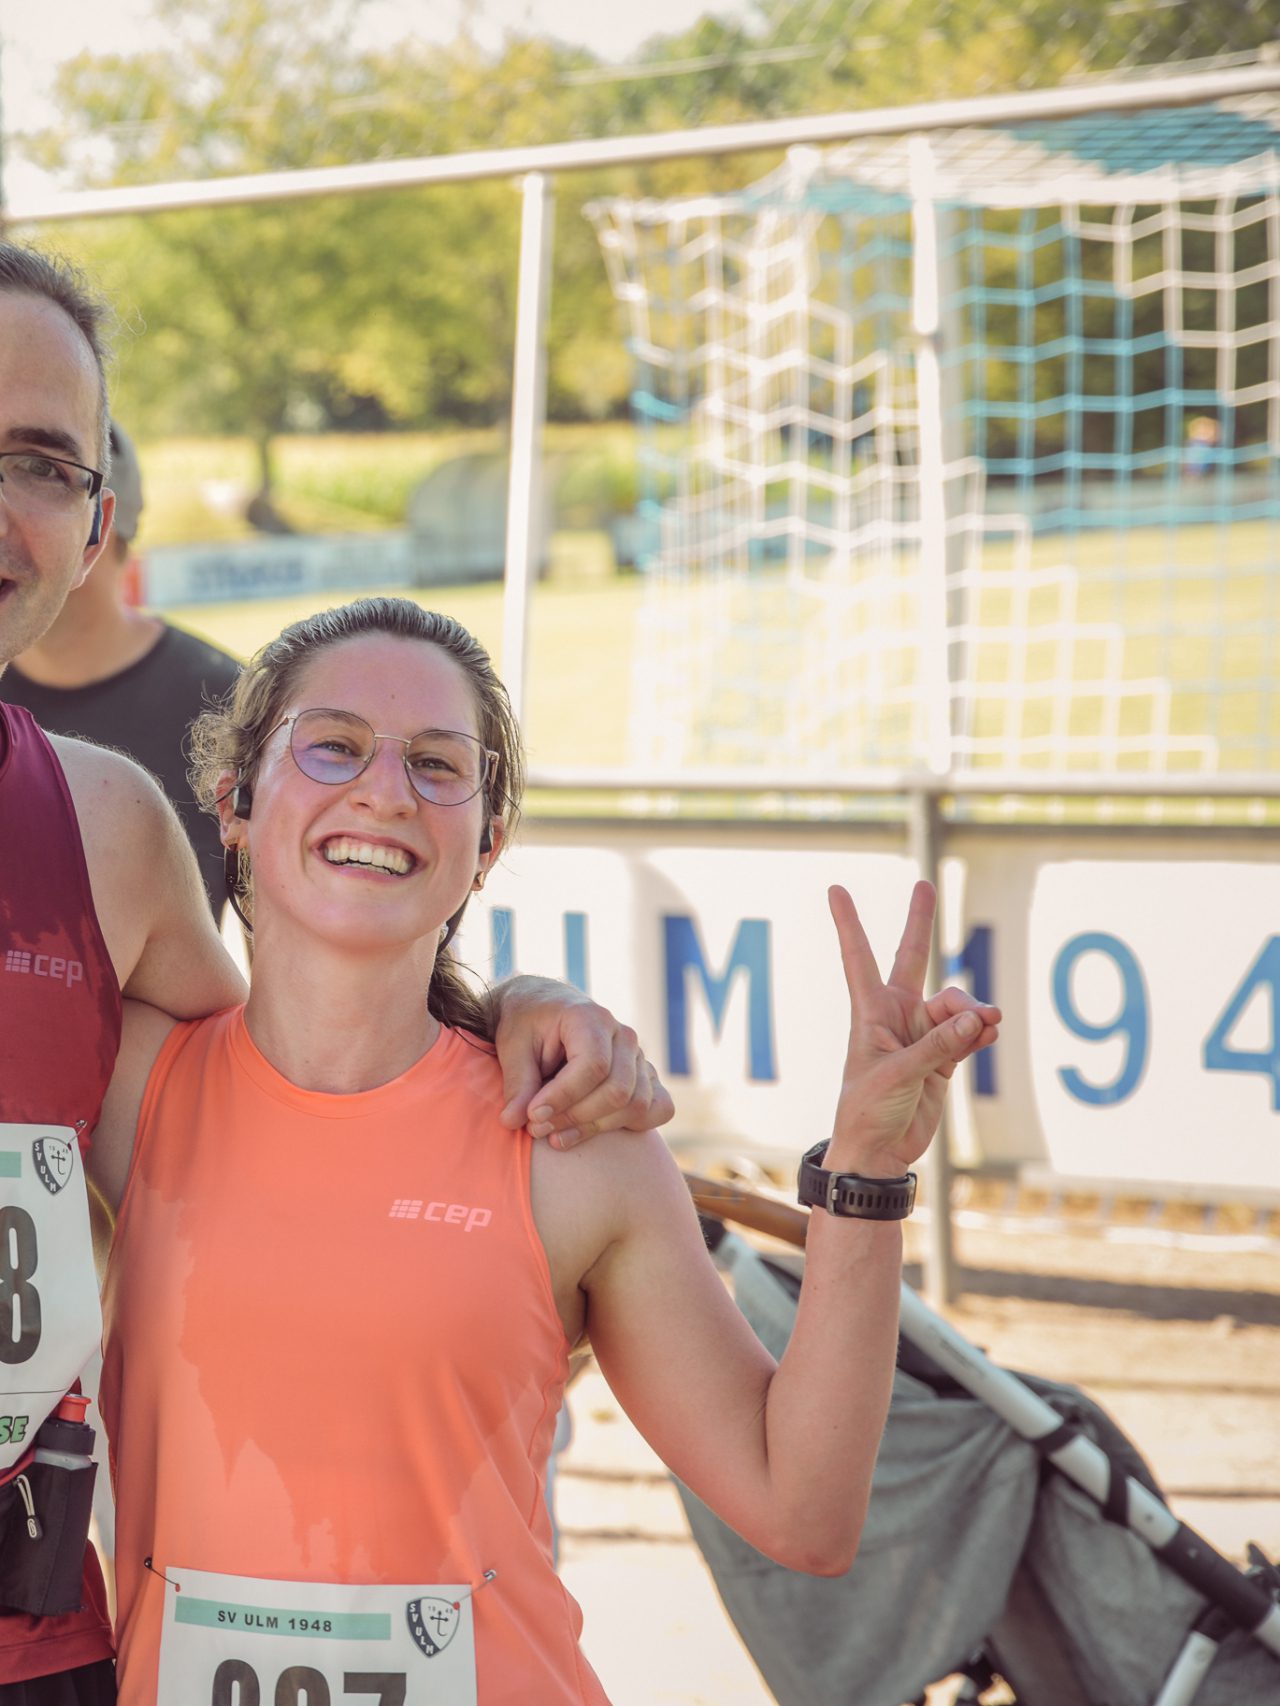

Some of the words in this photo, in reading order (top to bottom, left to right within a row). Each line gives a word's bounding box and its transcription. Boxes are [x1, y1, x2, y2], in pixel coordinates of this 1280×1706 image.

[34, 954, 84, 988] cep
[423, 1201, 492, 1232] cep
[217, 1610, 237, 1624] SV
[244, 1614, 279, 1630] ULM
[288, 1618, 333, 1633] 1948
